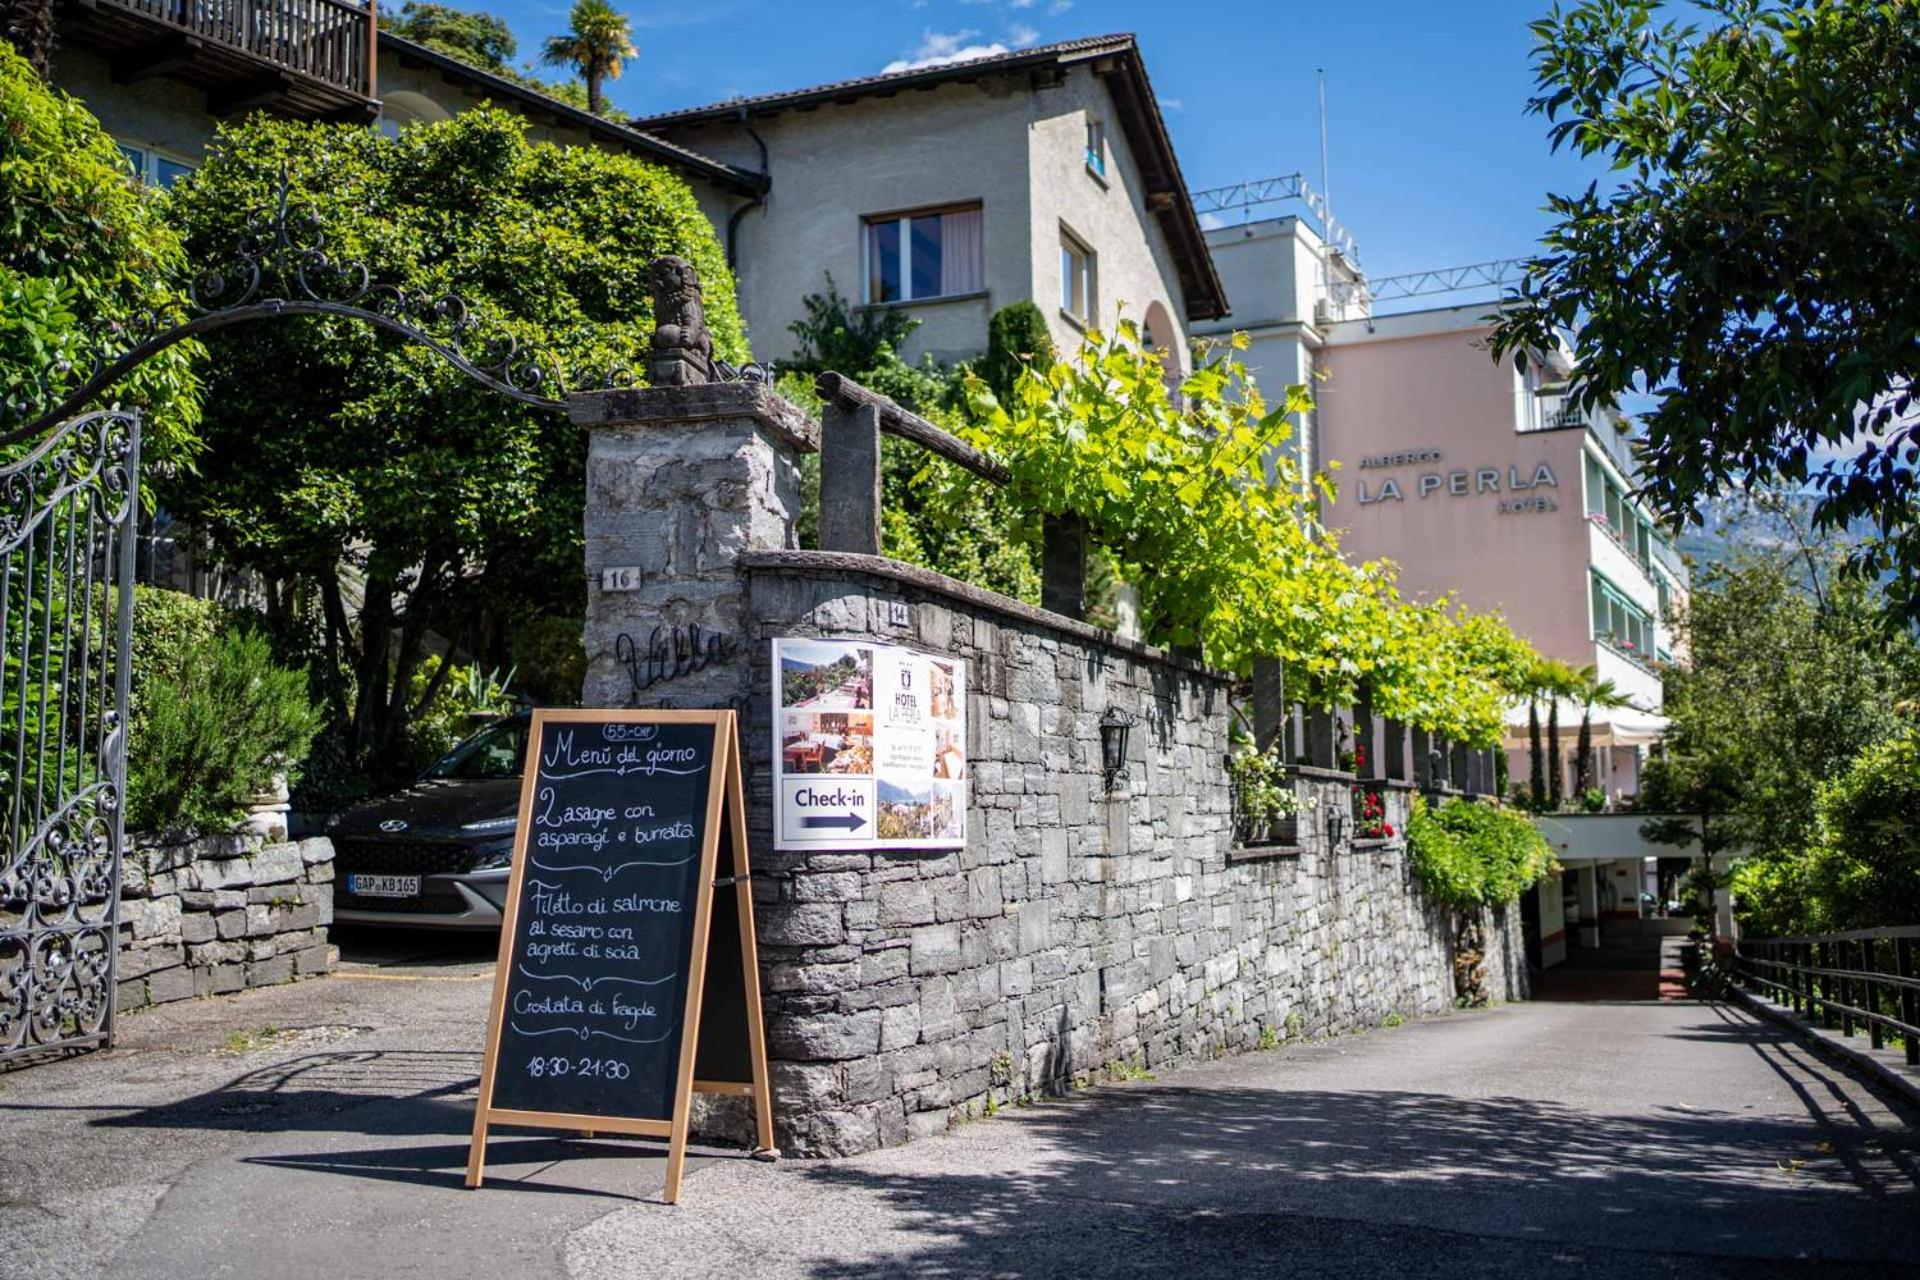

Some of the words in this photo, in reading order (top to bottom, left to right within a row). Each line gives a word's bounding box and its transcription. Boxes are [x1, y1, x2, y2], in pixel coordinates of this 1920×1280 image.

[1359, 450, 1442, 469] ALBERGO
[1357, 478, 1403, 505] LA
[1419, 462, 1558, 500] PERLA
[1497, 498, 1558, 514] HOTEL
[610, 570, 630, 588] 16
[894, 604, 905, 621] 14
[895, 692, 917, 708] HOTEL
[616, 745, 641, 764] del
[646, 741, 696, 776] giorno
[794, 787, 865, 807] Check-in
[624, 805, 655, 819] con
[537, 827, 610, 853] asparagi
[617, 831, 627, 842] e
[635, 820, 695, 844] burrata
[355, 876, 375, 890] GAP
[528, 879, 584, 916] Filetto
[587, 898, 608, 914] di
[612, 893, 682, 913] salmone
[529, 920, 546, 936] al
[550, 923, 603, 939] sesamo
[607, 927, 634, 940] con
[526, 942, 577, 965] agretti
[582, 945, 601, 958] di
[604, 945, 641, 960] soia
[513, 989, 585, 1015] Crostata
[588, 1000, 607, 1014] di
